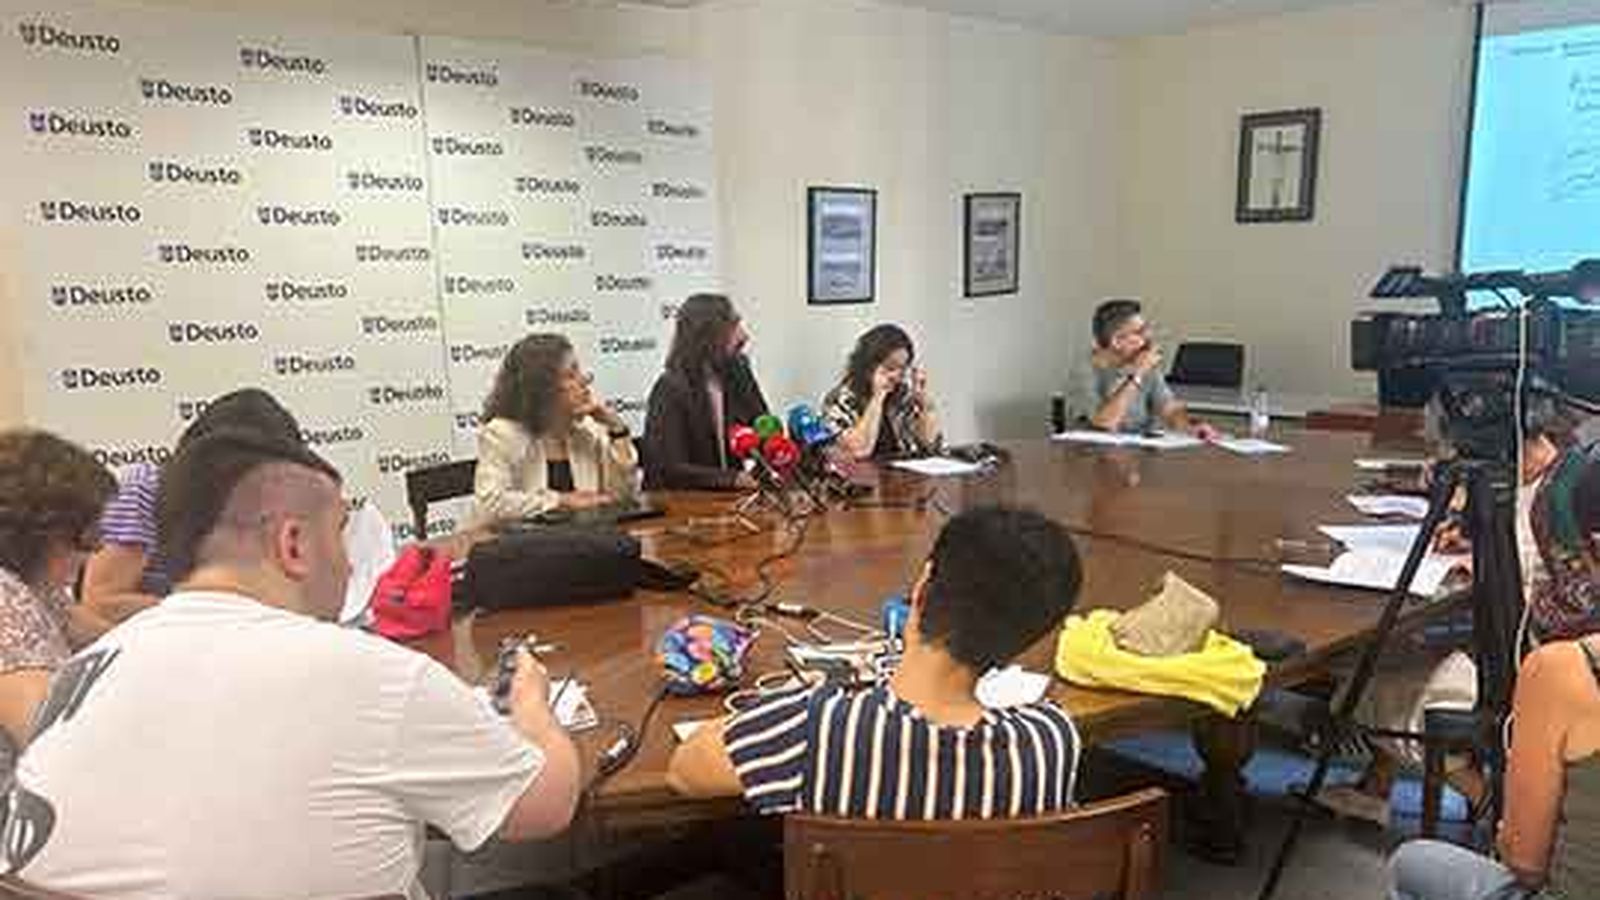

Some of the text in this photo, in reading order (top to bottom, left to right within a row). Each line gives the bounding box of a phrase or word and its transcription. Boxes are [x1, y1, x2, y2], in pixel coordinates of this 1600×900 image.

[39, 25, 120, 53] Deusto
[256, 50, 325, 73] Deusto
[157, 80, 232, 104] Deusto
[355, 97, 418, 119] Deusto
[49, 114, 131, 138] Deusto
[265, 129, 333, 150] Deusto
[167, 163, 240, 185] Deusto
[362, 172, 423, 191] Deusto
[60, 202, 140, 222] Deusto
[273, 207, 340, 225] Deusto
[176, 245, 249, 263] Deusto
[369, 245, 429, 261] Deusto
[71, 285, 150, 305] Deusto
[281, 281, 347, 299] Deusto
[186, 322, 259, 341] Deusto
[376, 316, 437, 333] Deusto
[290, 355, 354, 373] Deusto
[81, 366, 161, 388] Deusto
[384, 385, 443, 402] Deusto
